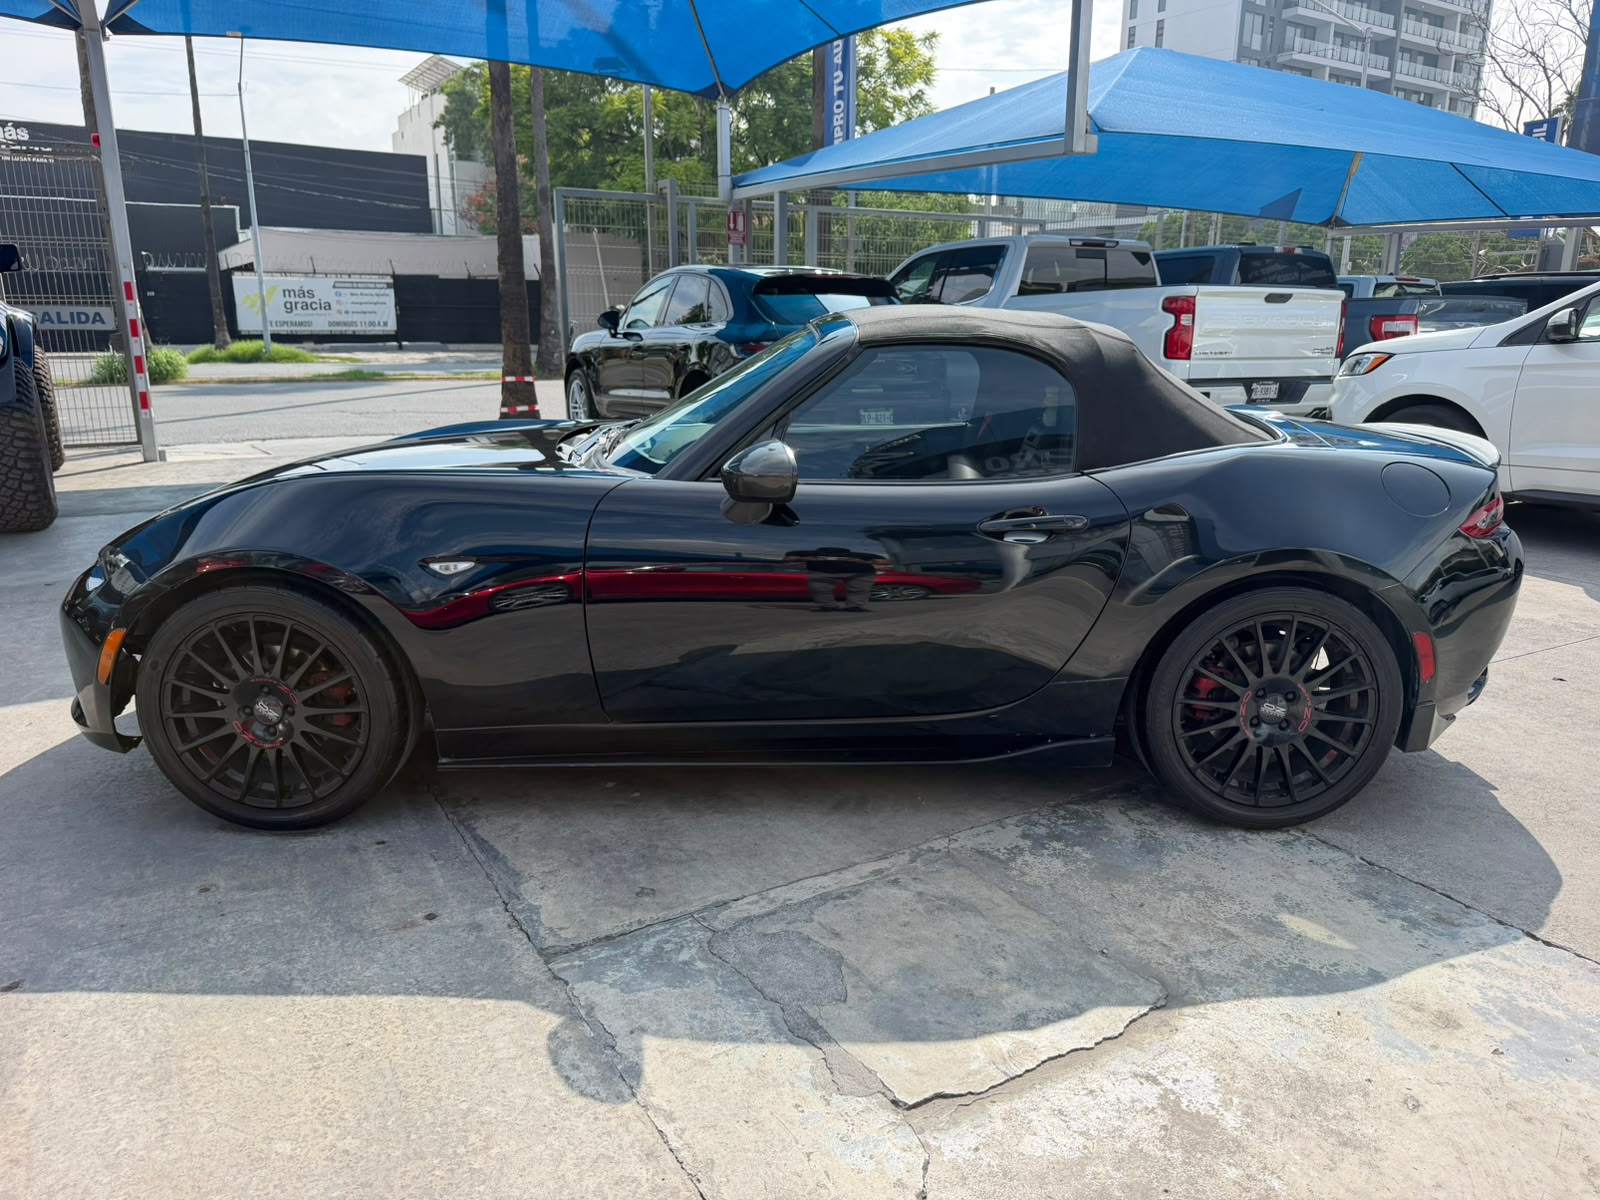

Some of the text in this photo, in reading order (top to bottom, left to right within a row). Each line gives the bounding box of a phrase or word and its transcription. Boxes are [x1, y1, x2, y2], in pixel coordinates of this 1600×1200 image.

[833, 69, 844, 97] TU
[282, 285, 315, 299] más
[283, 298, 332, 314] gracia
